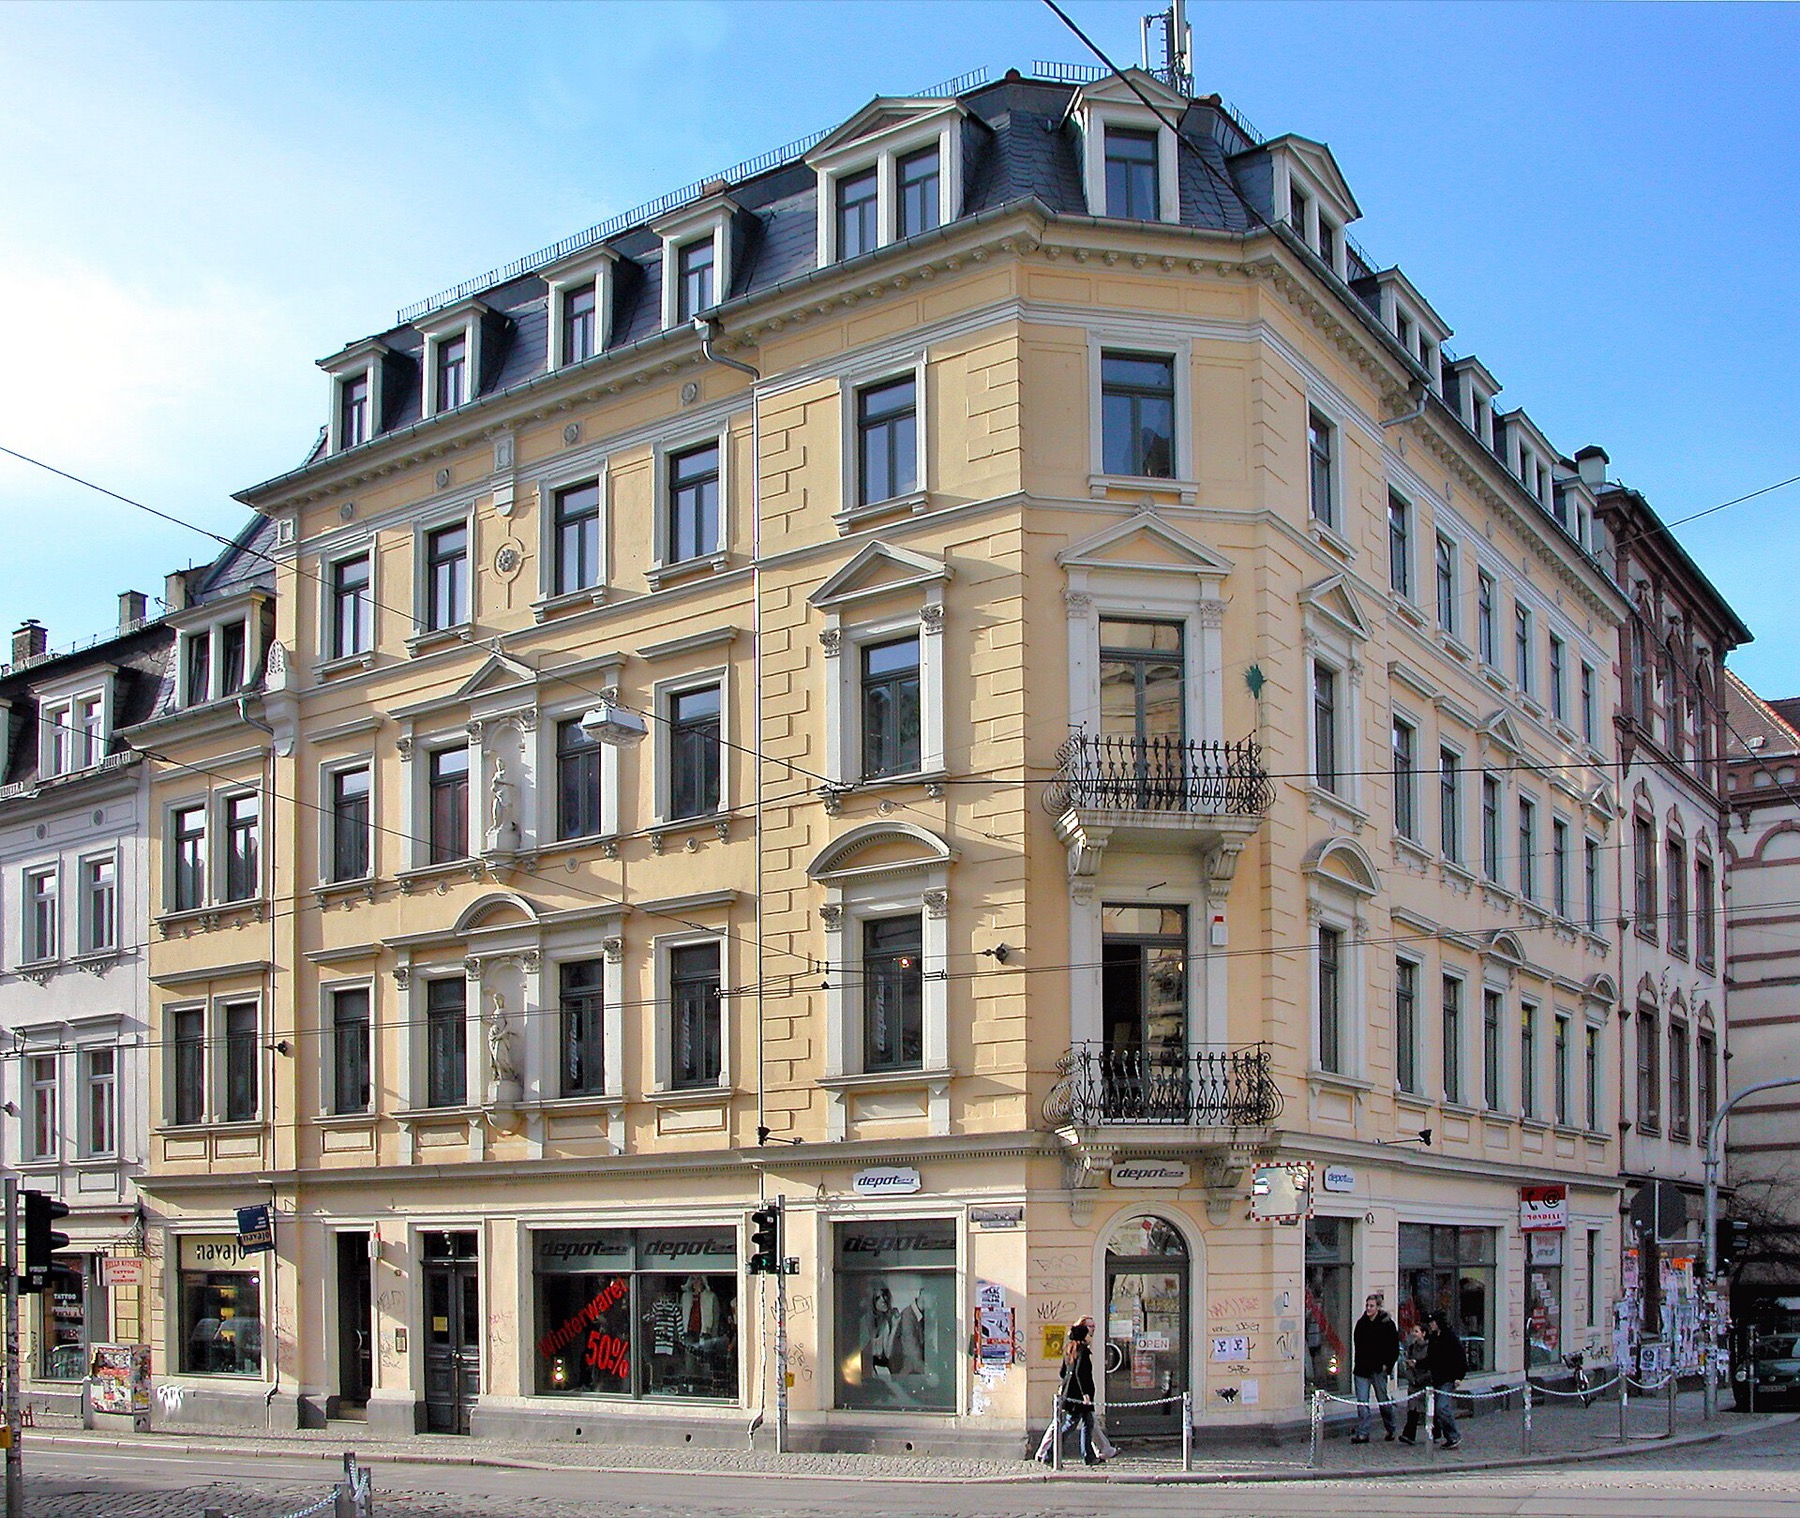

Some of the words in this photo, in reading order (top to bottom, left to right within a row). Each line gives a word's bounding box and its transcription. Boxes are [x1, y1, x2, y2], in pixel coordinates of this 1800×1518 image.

[857, 1174, 899, 1188] depot
[1116, 1168, 1166, 1180] depot
[243, 1231, 270, 1241] navajo
[196, 1243, 246, 1267] navajo
[542, 1240, 605, 1261] depot
[644, 1238, 716, 1260] depot
[1139, 1340, 1168, 1349] OPEN
[585, 1331, 630, 1379] 50%
